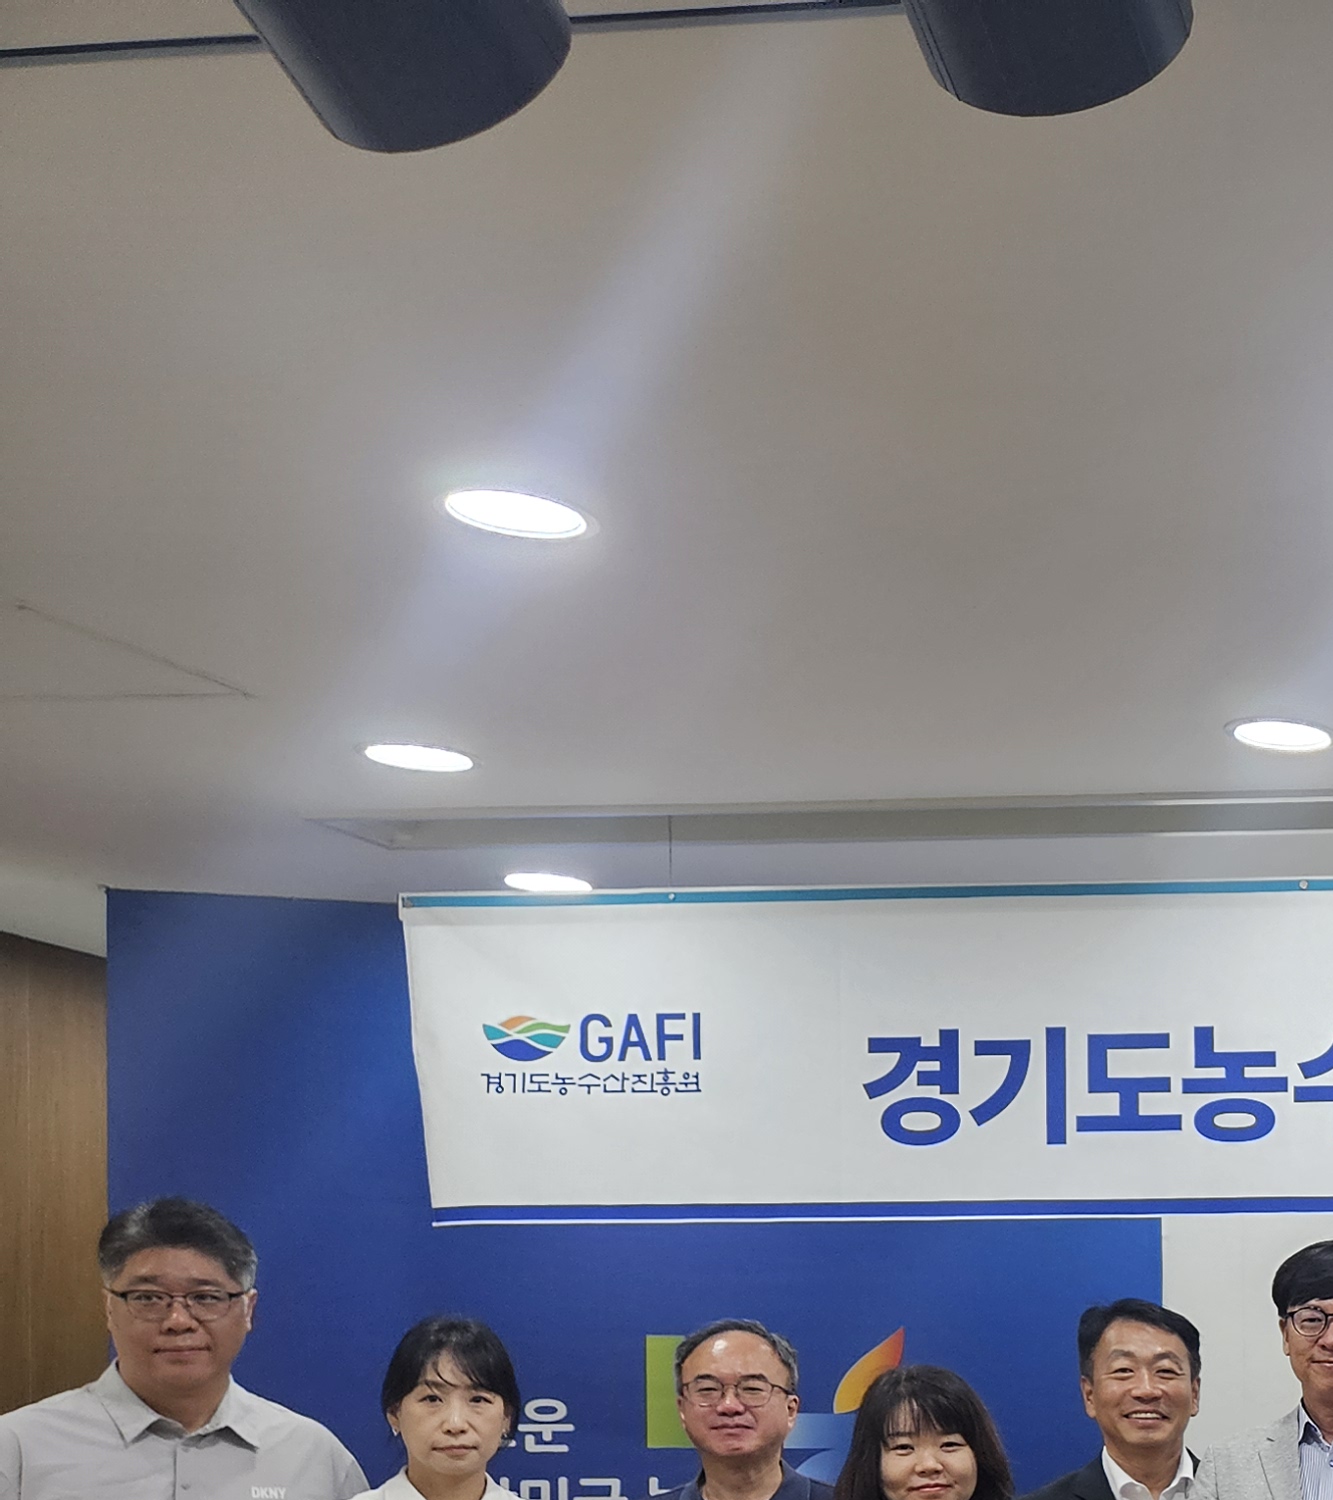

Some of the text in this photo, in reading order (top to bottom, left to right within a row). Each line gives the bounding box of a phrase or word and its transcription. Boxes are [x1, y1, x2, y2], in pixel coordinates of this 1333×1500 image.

[579, 1011, 702, 1063] GAFI
[481, 1068, 702, 1097] 경기도농수산진흥원
[251, 1486, 286, 1500] DKNY
